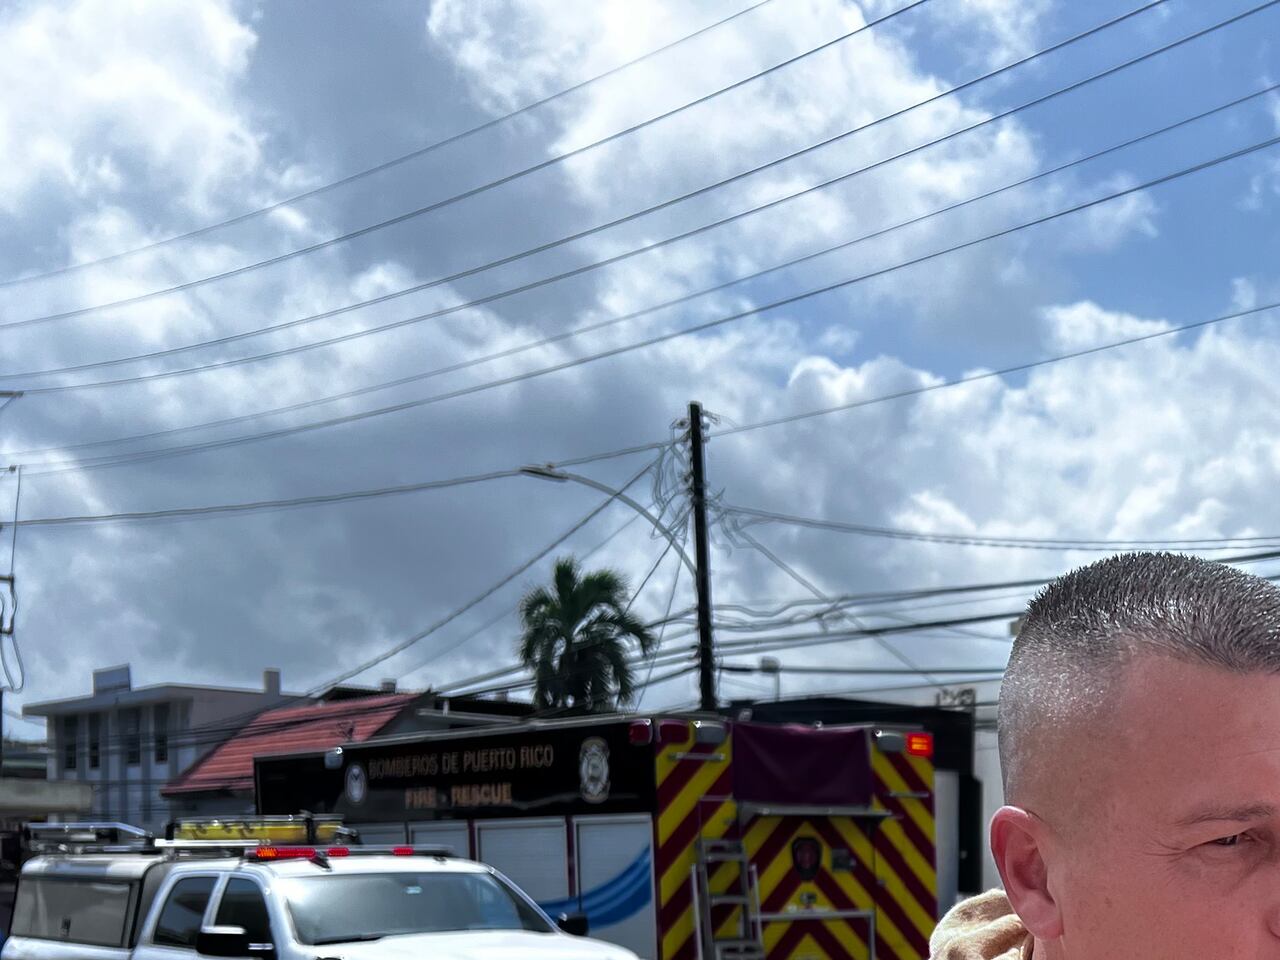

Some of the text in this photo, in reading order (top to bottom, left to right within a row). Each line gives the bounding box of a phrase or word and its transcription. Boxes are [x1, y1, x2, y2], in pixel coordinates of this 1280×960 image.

[368, 744, 554, 779] BOMBEROS DE PUERTO RICO
[404, 786, 437, 808] FIRE
[450, 782, 513, 806] RESCUE
